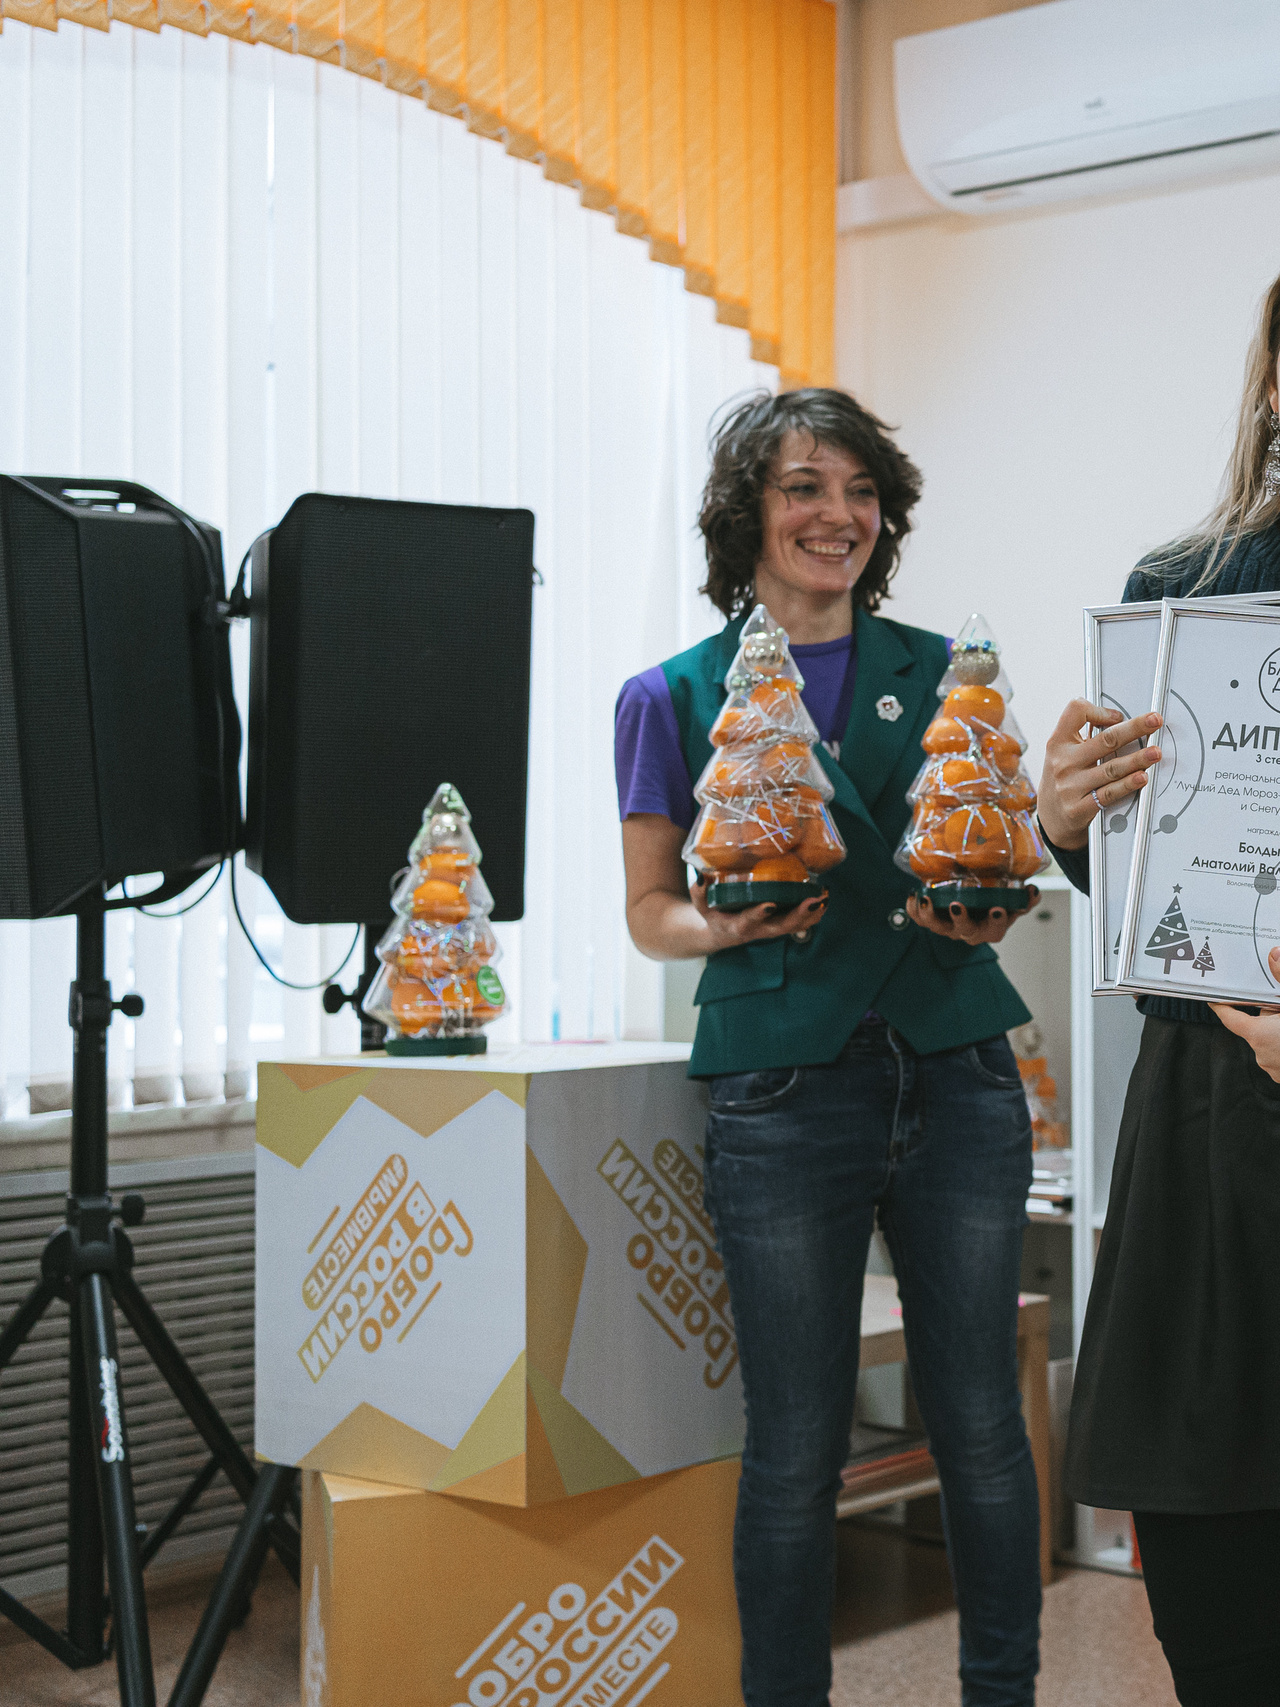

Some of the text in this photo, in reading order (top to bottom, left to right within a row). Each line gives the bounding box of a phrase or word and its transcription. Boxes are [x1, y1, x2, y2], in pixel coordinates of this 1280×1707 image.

[1255, 754, 1262, 763] 3
[1217, 784, 1241, 796] Дед
[1240, 803, 1248, 811] и
[1191, 856, 1256, 874] Анатолий
[301, 1218, 411, 1380] РОССИИ
